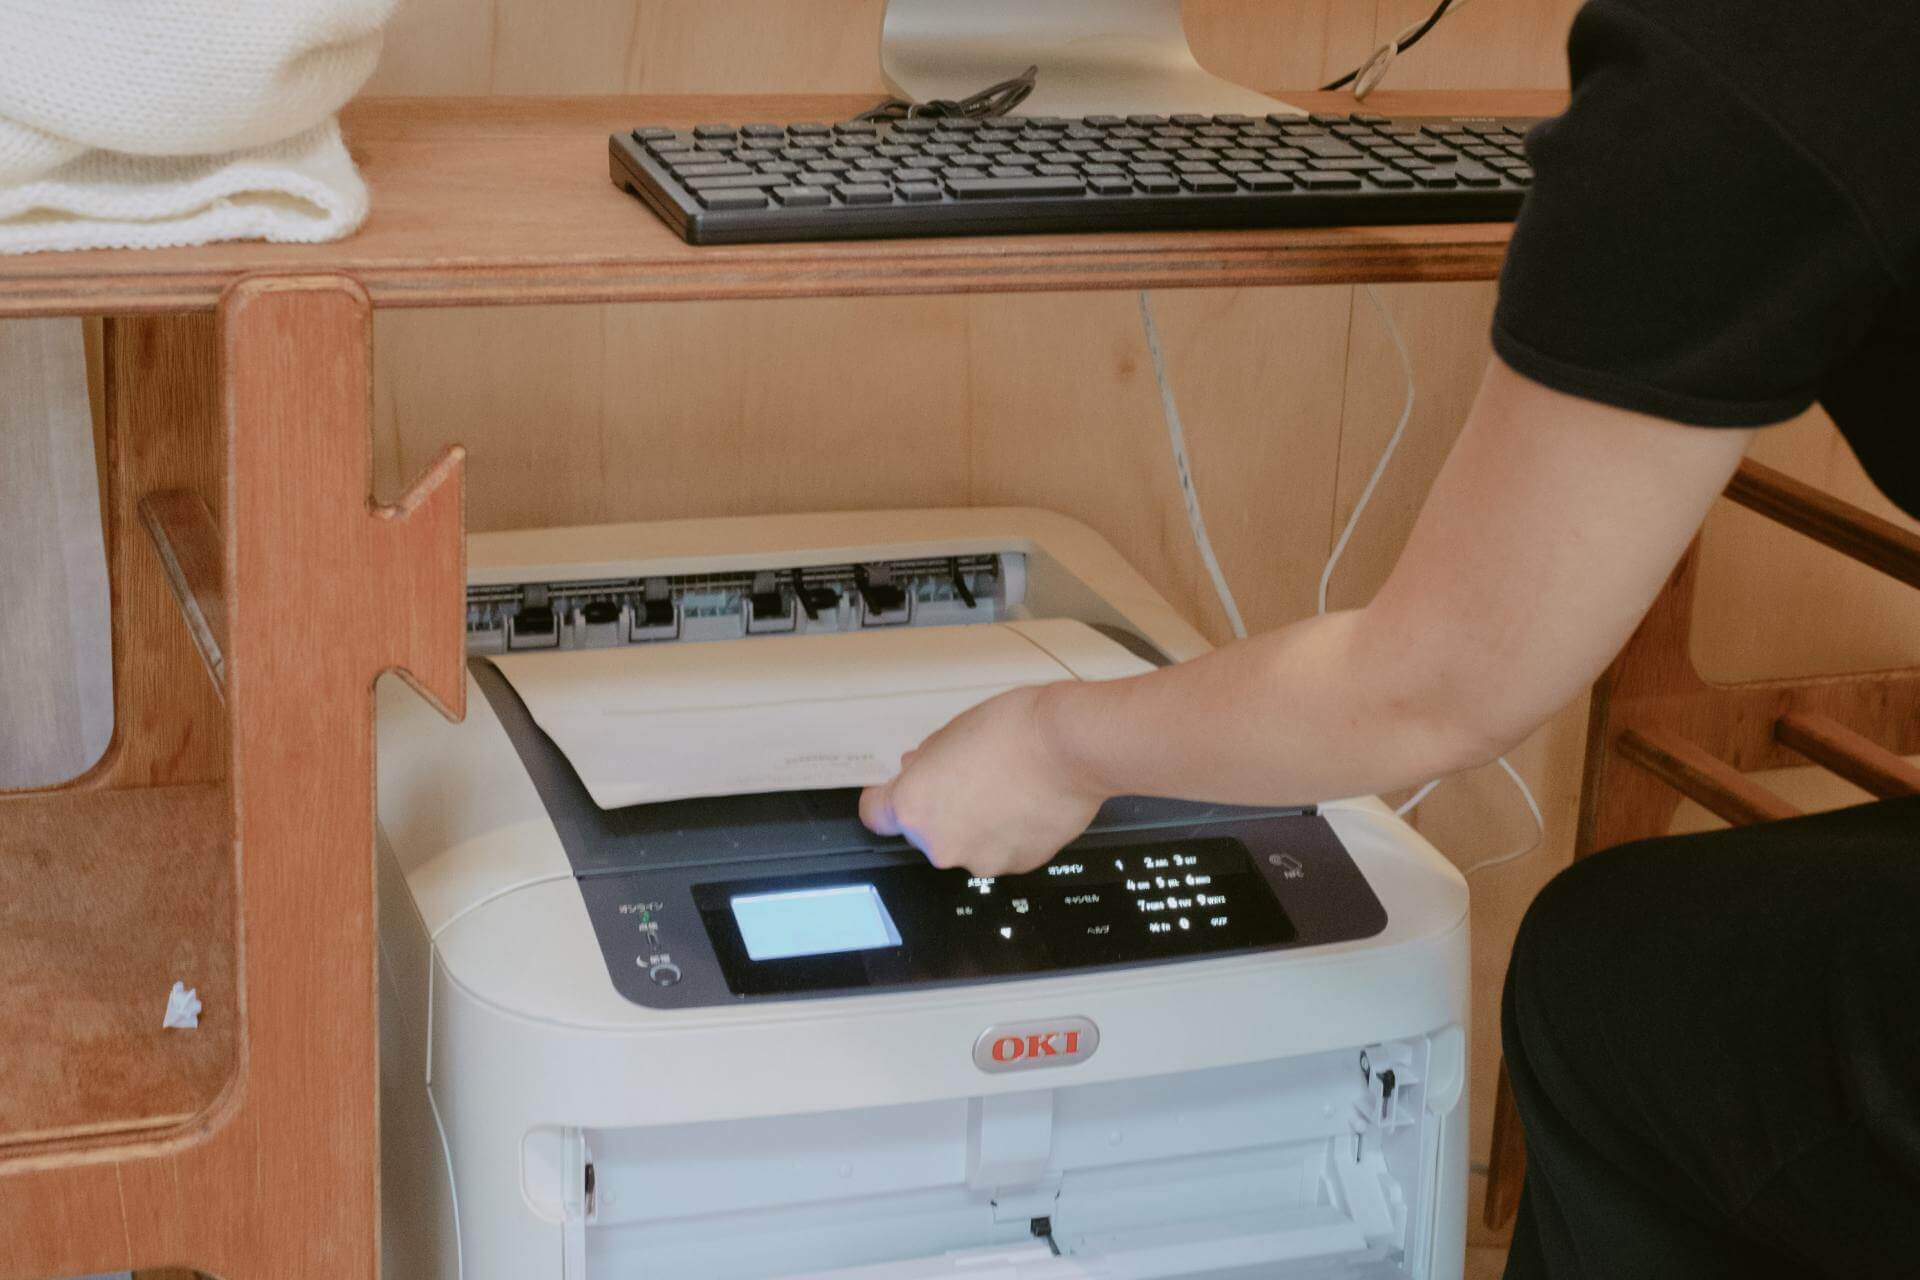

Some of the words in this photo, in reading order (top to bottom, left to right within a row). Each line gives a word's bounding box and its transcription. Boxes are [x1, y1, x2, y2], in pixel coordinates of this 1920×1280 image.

[1115, 859, 1123, 871] 1
[1144, 857, 1154, 869] 2
[1126, 879, 1136, 891] 4
[1185, 874, 1195, 886] 6
[1137, 899, 1146, 912] 7
[1196, 894, 1206, 906] 9
[992, 1031, 1080, 1061] OKI
